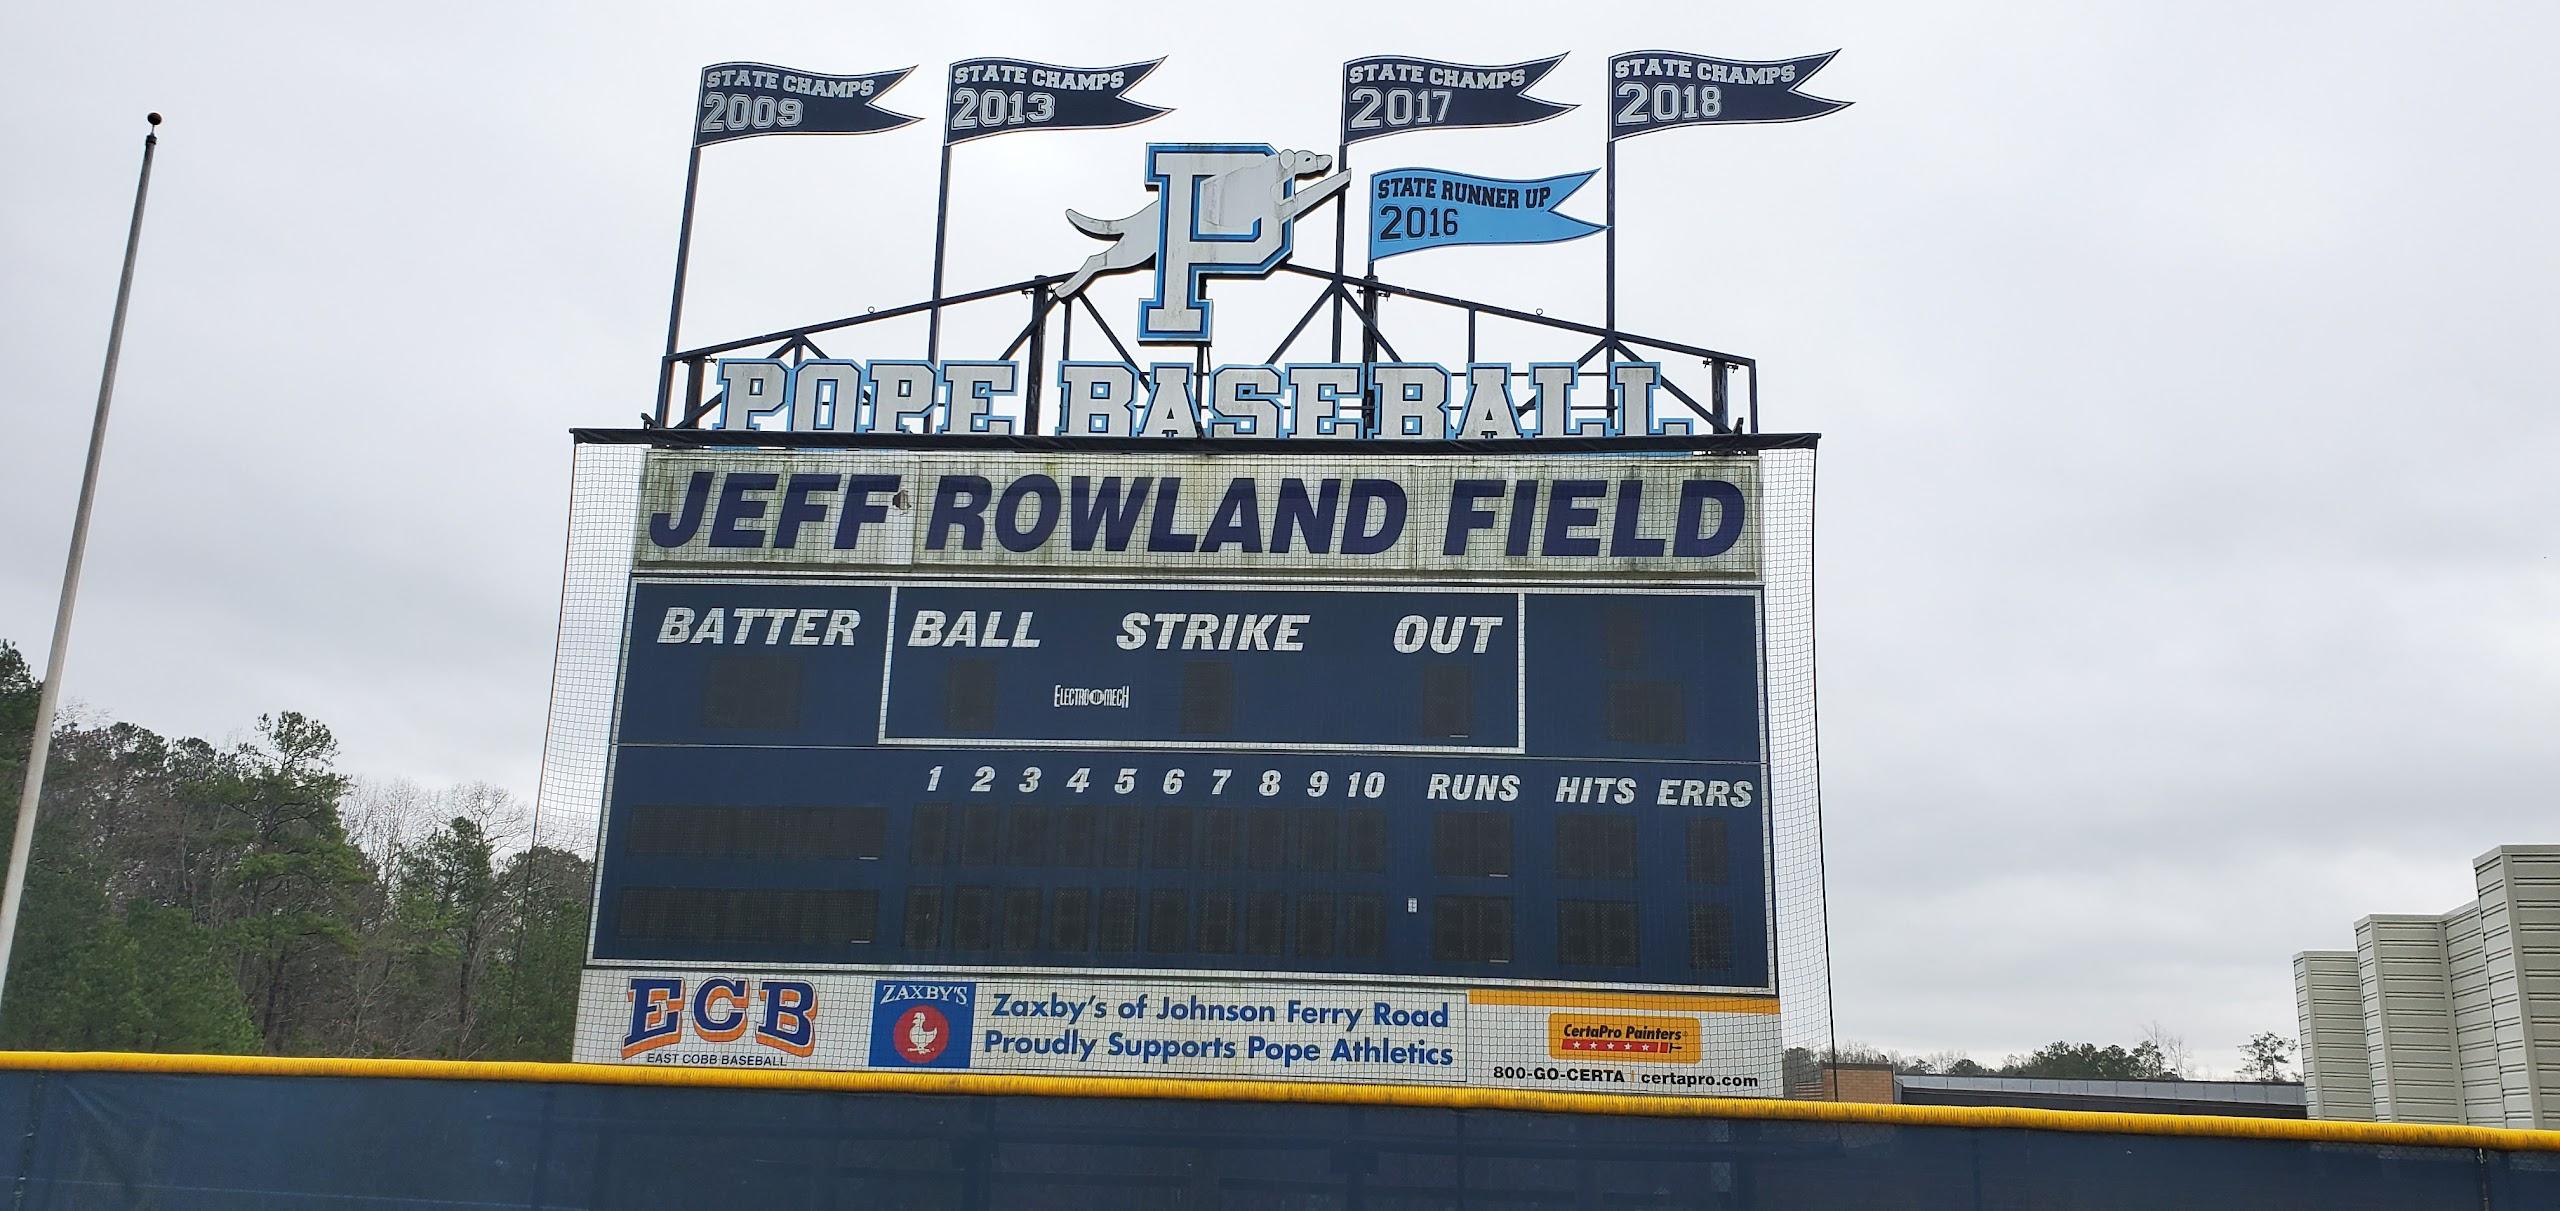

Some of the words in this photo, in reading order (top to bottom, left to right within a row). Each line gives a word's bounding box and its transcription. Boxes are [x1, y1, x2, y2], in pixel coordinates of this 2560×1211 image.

[706, 69, 778, 90] STATE
[782, 74, 874, 99] CHAMPS
[954, 65, 1027, 87] STATE
[1031, 69, 1125, 91] CHAMPS
[1349, 64, 1424, 85] STATE
[1429, 67, 1526, 90] CHAMPS
[1614, 58, 1693, 80] STATE
[1697, 62, 1797, 85] CHAMPS
[701, 93, 804, 132] 2009
[951, 89, 1056, 129] 2013
[1349, 87, 1453, 129] 2017
[1615, 82, 1723, 125] 2018
[1377, 176, 1437, 202] STATE
[1441, 180, 1520, 209] RUNNER
[1524, 186, 1551, 209] UP
[1138, 142, 1294, 342] P
[1378, 205, 1459, 242] 2016
[712, 358, 1019, 434] POPE
[1056, 360, 1694, 439] BASEBALL
[649, 471, 901, 550] JEFF
[924, 474, 1408, 553] ROWLAND
[1443, 479, 1745, 557] FIELD
[657, 607, 862, 646] BATTER
[907, 610, 1041, 648] BALL
[1116, 612, 1311, 653] STRIKE
[1393, 615, 1503, 654] OUT
[927, 766, 944, 792] 1
[970, 766, 996, 792] 2
[1018, 766, 1042, 793] 3
[1066, 767, 1091, 793] 4
[1114, 768, 1138, 794] 5
[1162, 768, 1185, 795] 6
[1211, 769, 1232, 795] 7
[1258, 769, 1281, 796] 8
[1307, 770, 1329, 798] 9
[1347, 771, 1386, 798] 10
[1427, 773, 1521, 801] RUNS
[1555, 776, 1637, 805] HITS
[1656, 779, 1754, 807] ERRS
[879, 984, 969, 1005] ZAXBY'S
[991, 992, 1107, 1024] Zaxby's
[1117, 994, 1148, 1019] of
[1157, 995, 1276, 1023] Johnson
[1287, 1000, 1363, 1032] Ferry
[1373, 1001, 1448, 1028] Road
[621, 975, 818, 1060] ECB
[1563, 1023, 1622, 1039] CertaPro
[1625, 1026, 1682, 1040] Painters
[646, 1052, 679, 1065] EAST
[682, 1053, 720, 1065] COBB
[721, 1054, 788, 1067] BASEBALL
[984, 1029, 1097, 1062] Proudly
[1107, 1032, 1236, 1064] Supports
[1248, 1036, 1320, 1067] Pope
[1330, 1037, 1454, 1066] Athletics
[1493, 1066, 1625, 1083] 800-GO-CERTA
[1641, 1071, 1758, 1088] certapro.com
